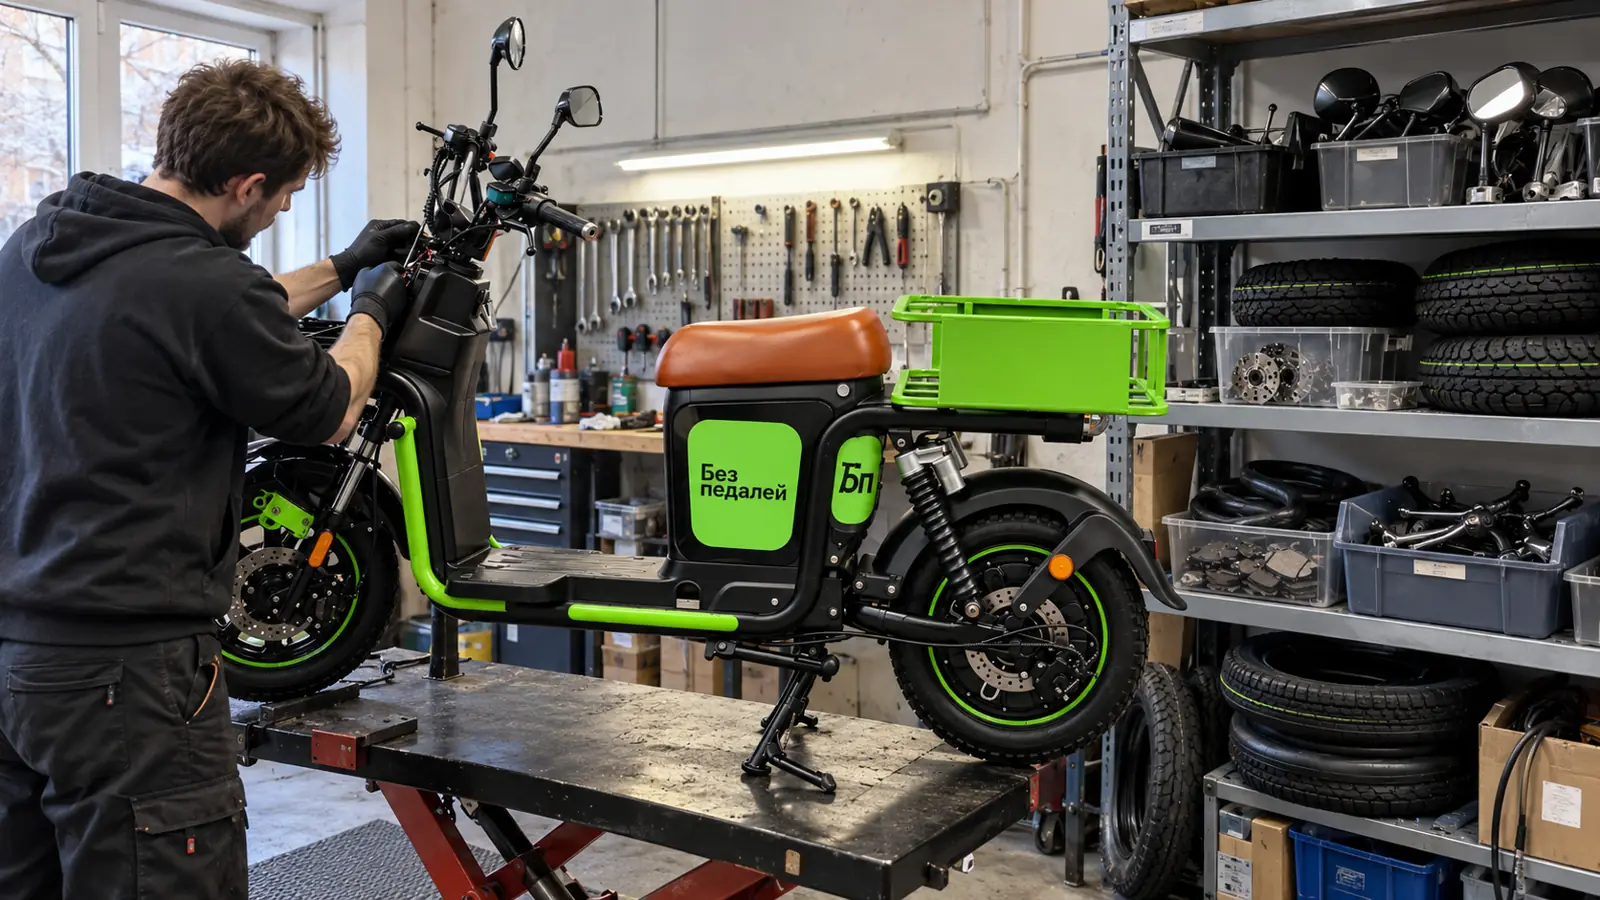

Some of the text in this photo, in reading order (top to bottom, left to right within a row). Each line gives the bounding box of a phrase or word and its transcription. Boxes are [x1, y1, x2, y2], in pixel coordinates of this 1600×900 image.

[701, 463, 738, 482] Без
[839, 462, 874, 494] Бп
[700, 483, 787, 501] педалей
